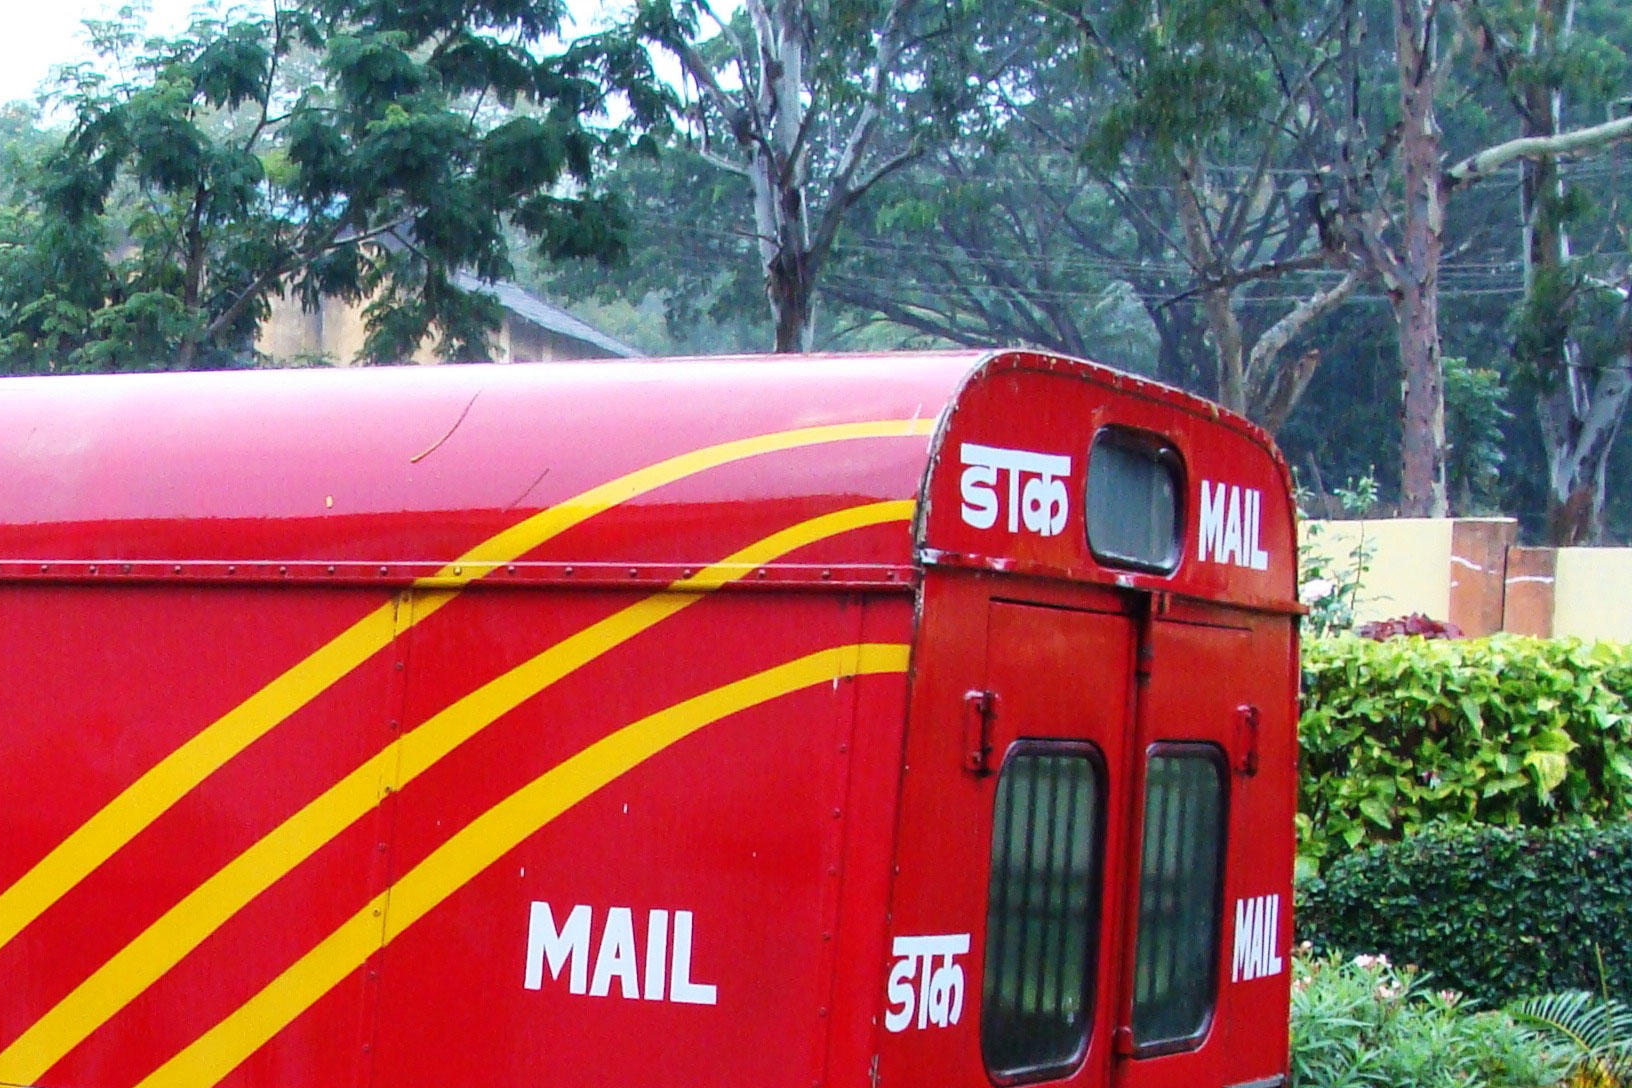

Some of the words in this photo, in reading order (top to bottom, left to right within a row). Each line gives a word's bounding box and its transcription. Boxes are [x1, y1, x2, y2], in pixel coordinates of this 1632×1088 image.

[961, 443, 1071, 537] डाक
[1198, 480, 1268, 571] MAIL
[524, 901, 717, 1005] MAIL
[885, 933, 970, 1033] डाक
[1232, 894, 1282, 983] MAIL
